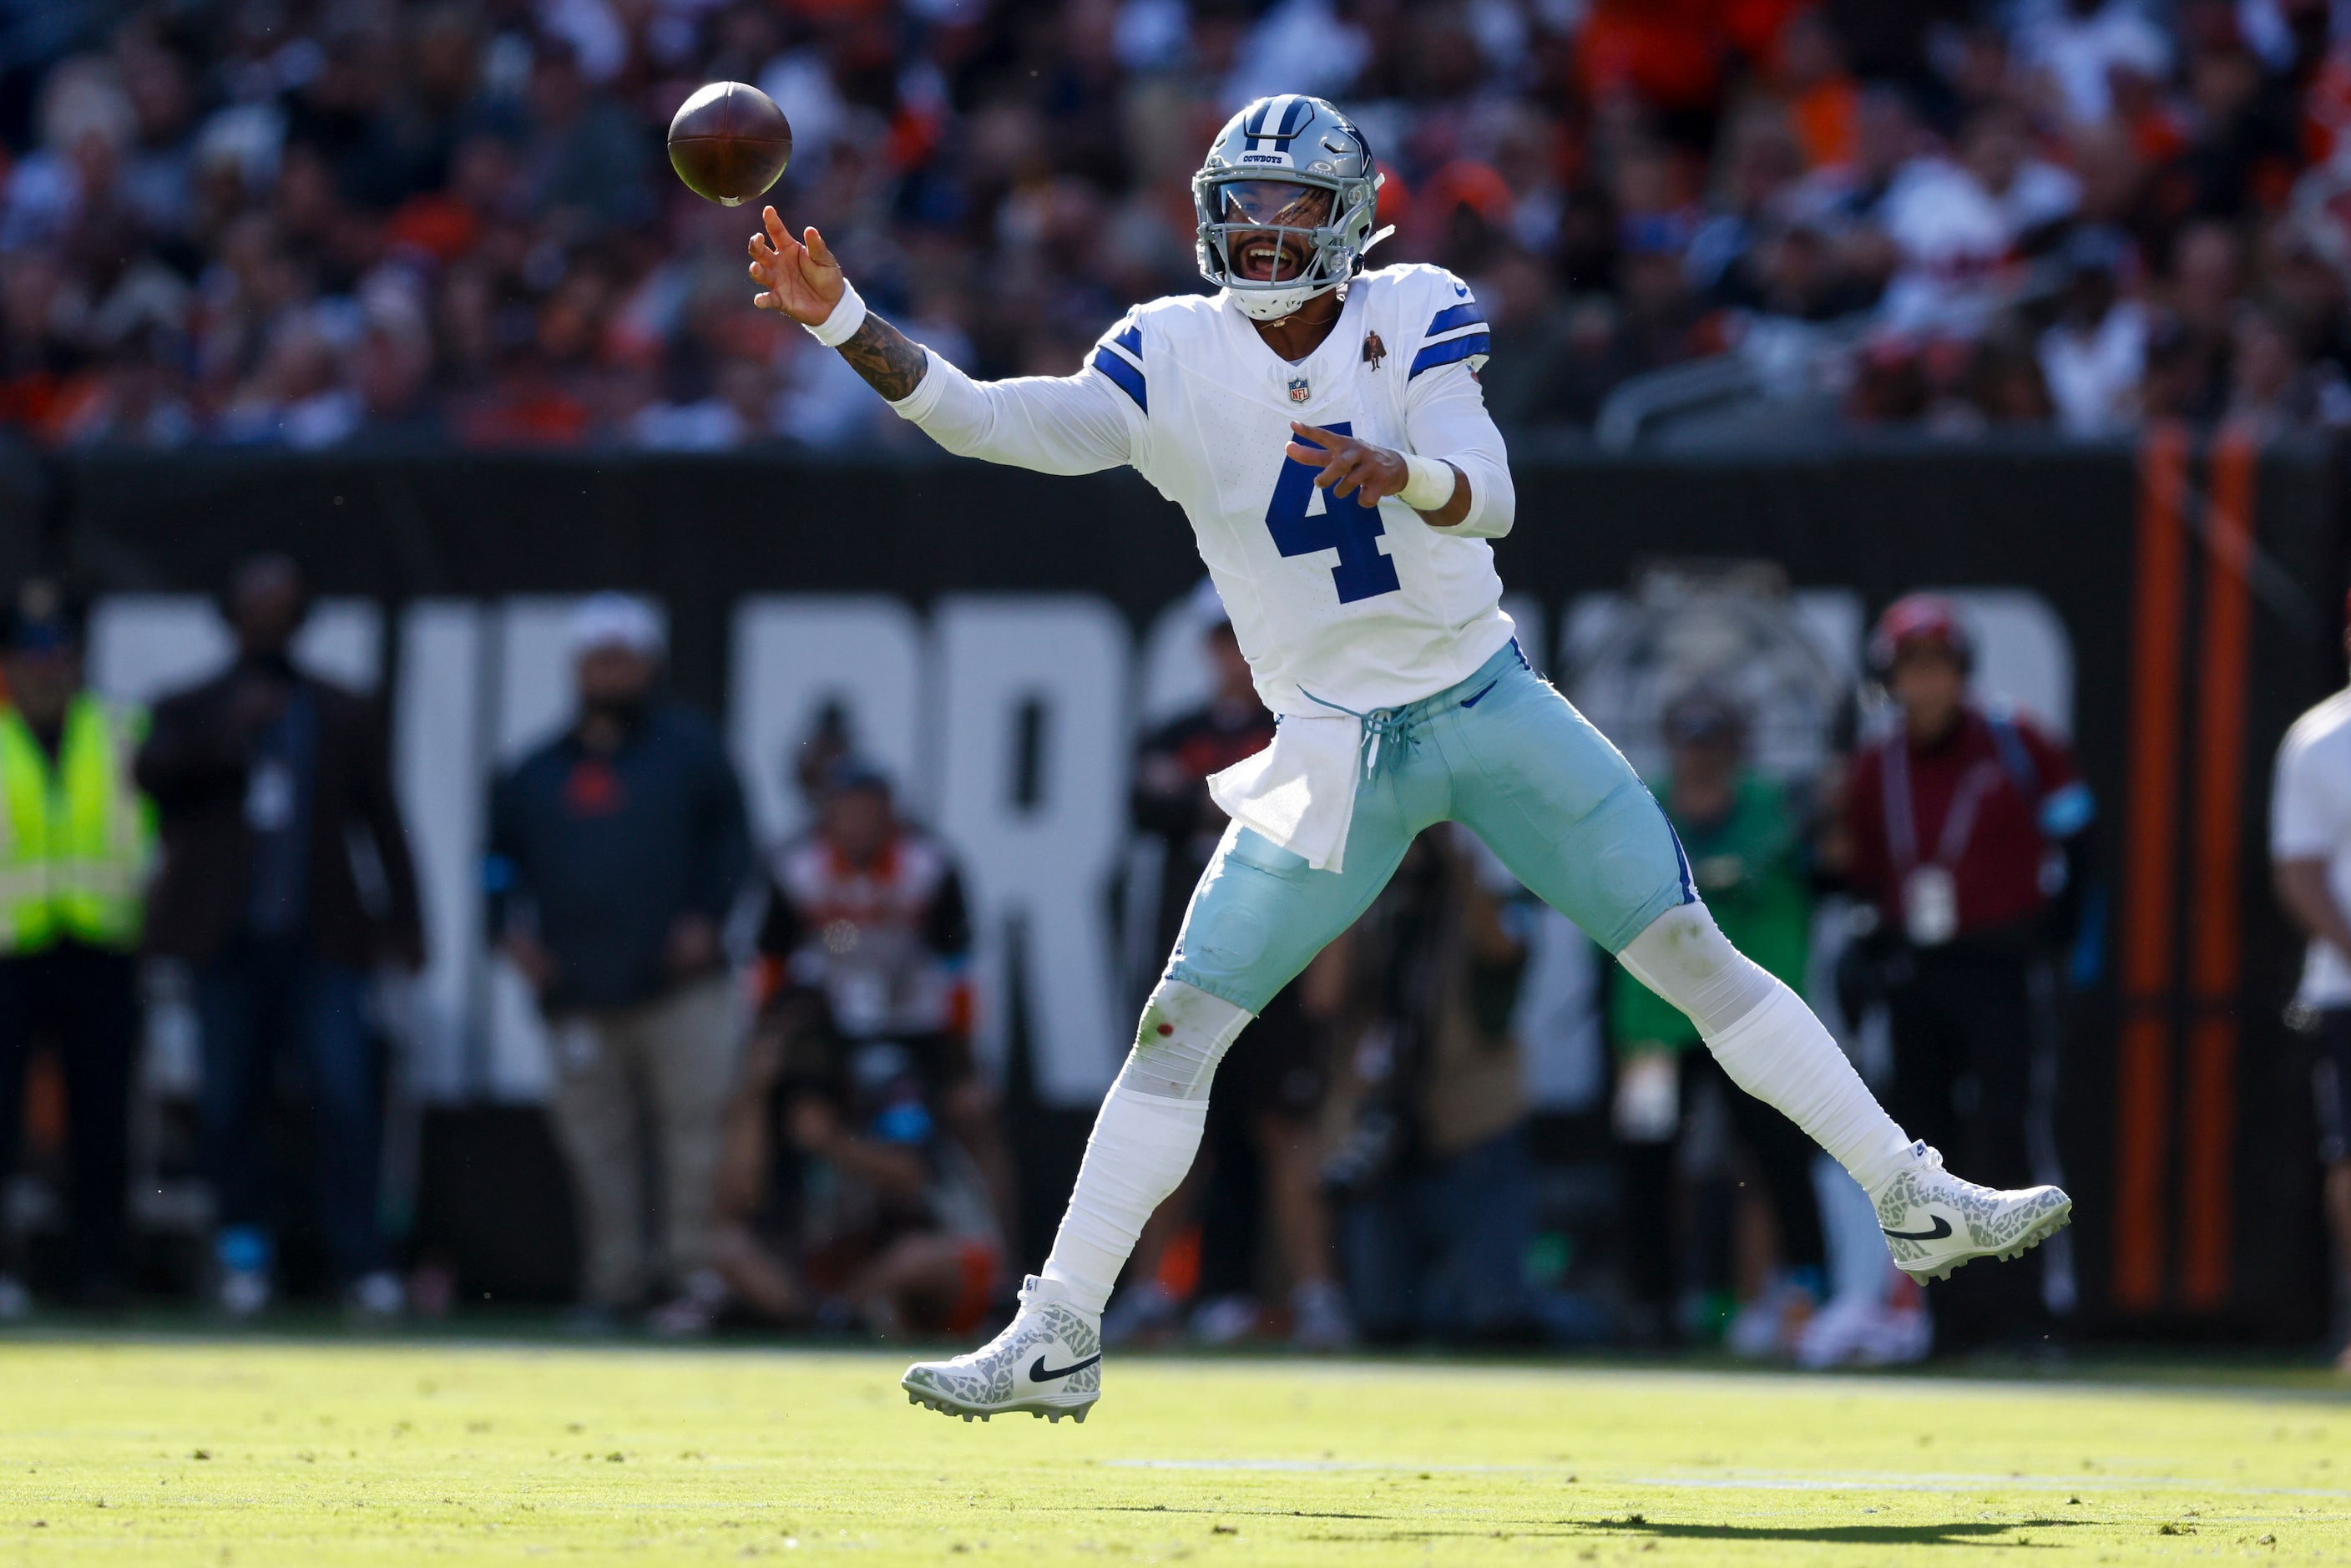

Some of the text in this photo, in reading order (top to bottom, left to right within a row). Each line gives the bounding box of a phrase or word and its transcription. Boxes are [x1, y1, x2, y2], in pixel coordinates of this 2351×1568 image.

[1243, 155, 1282, 164] COWBOYS
[1292, 388, 1308, 400] NFL
[1265, 422, 1401, 604] 4
